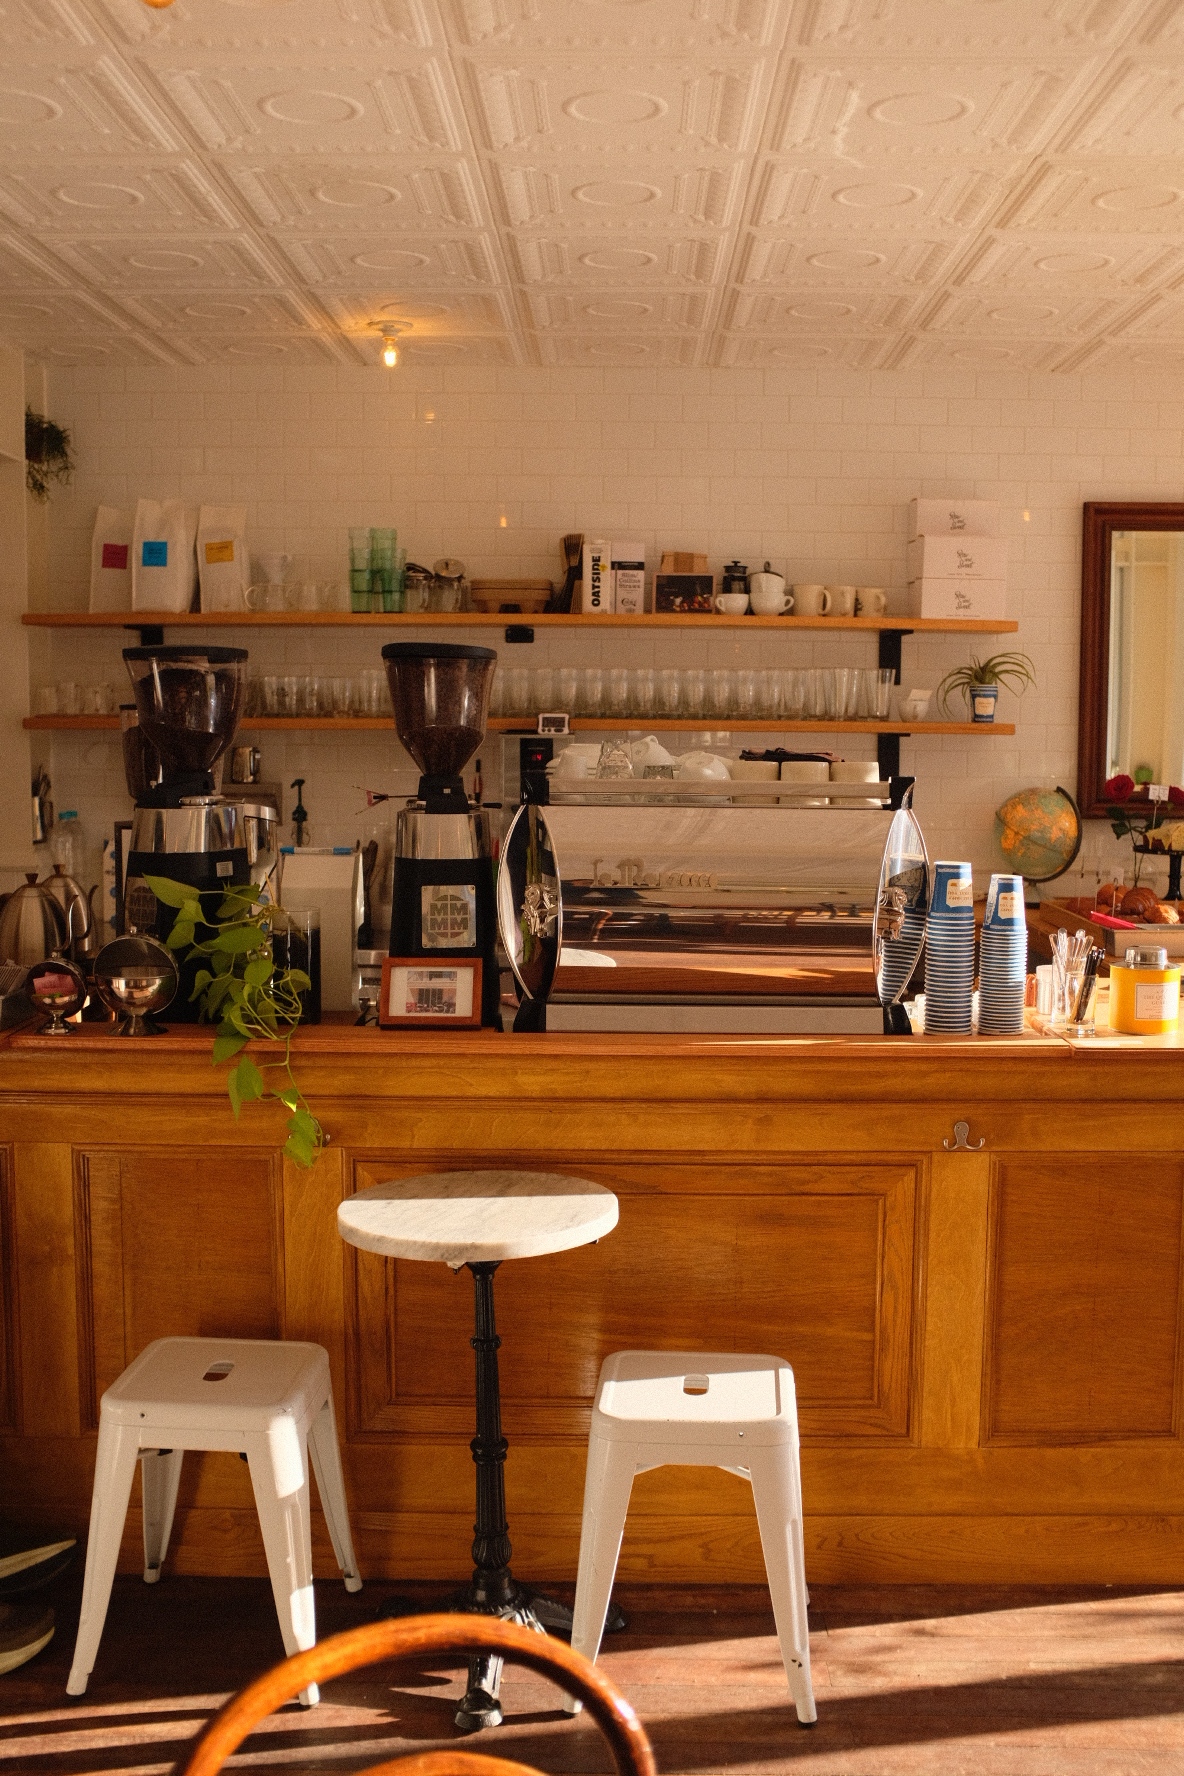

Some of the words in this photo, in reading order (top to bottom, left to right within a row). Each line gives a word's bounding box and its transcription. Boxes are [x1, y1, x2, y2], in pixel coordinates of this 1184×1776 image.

[591, 556, 601, 607] OATSIDE
[430, 903, 468, 916] MM
[430, 917, 469, 931] MM
